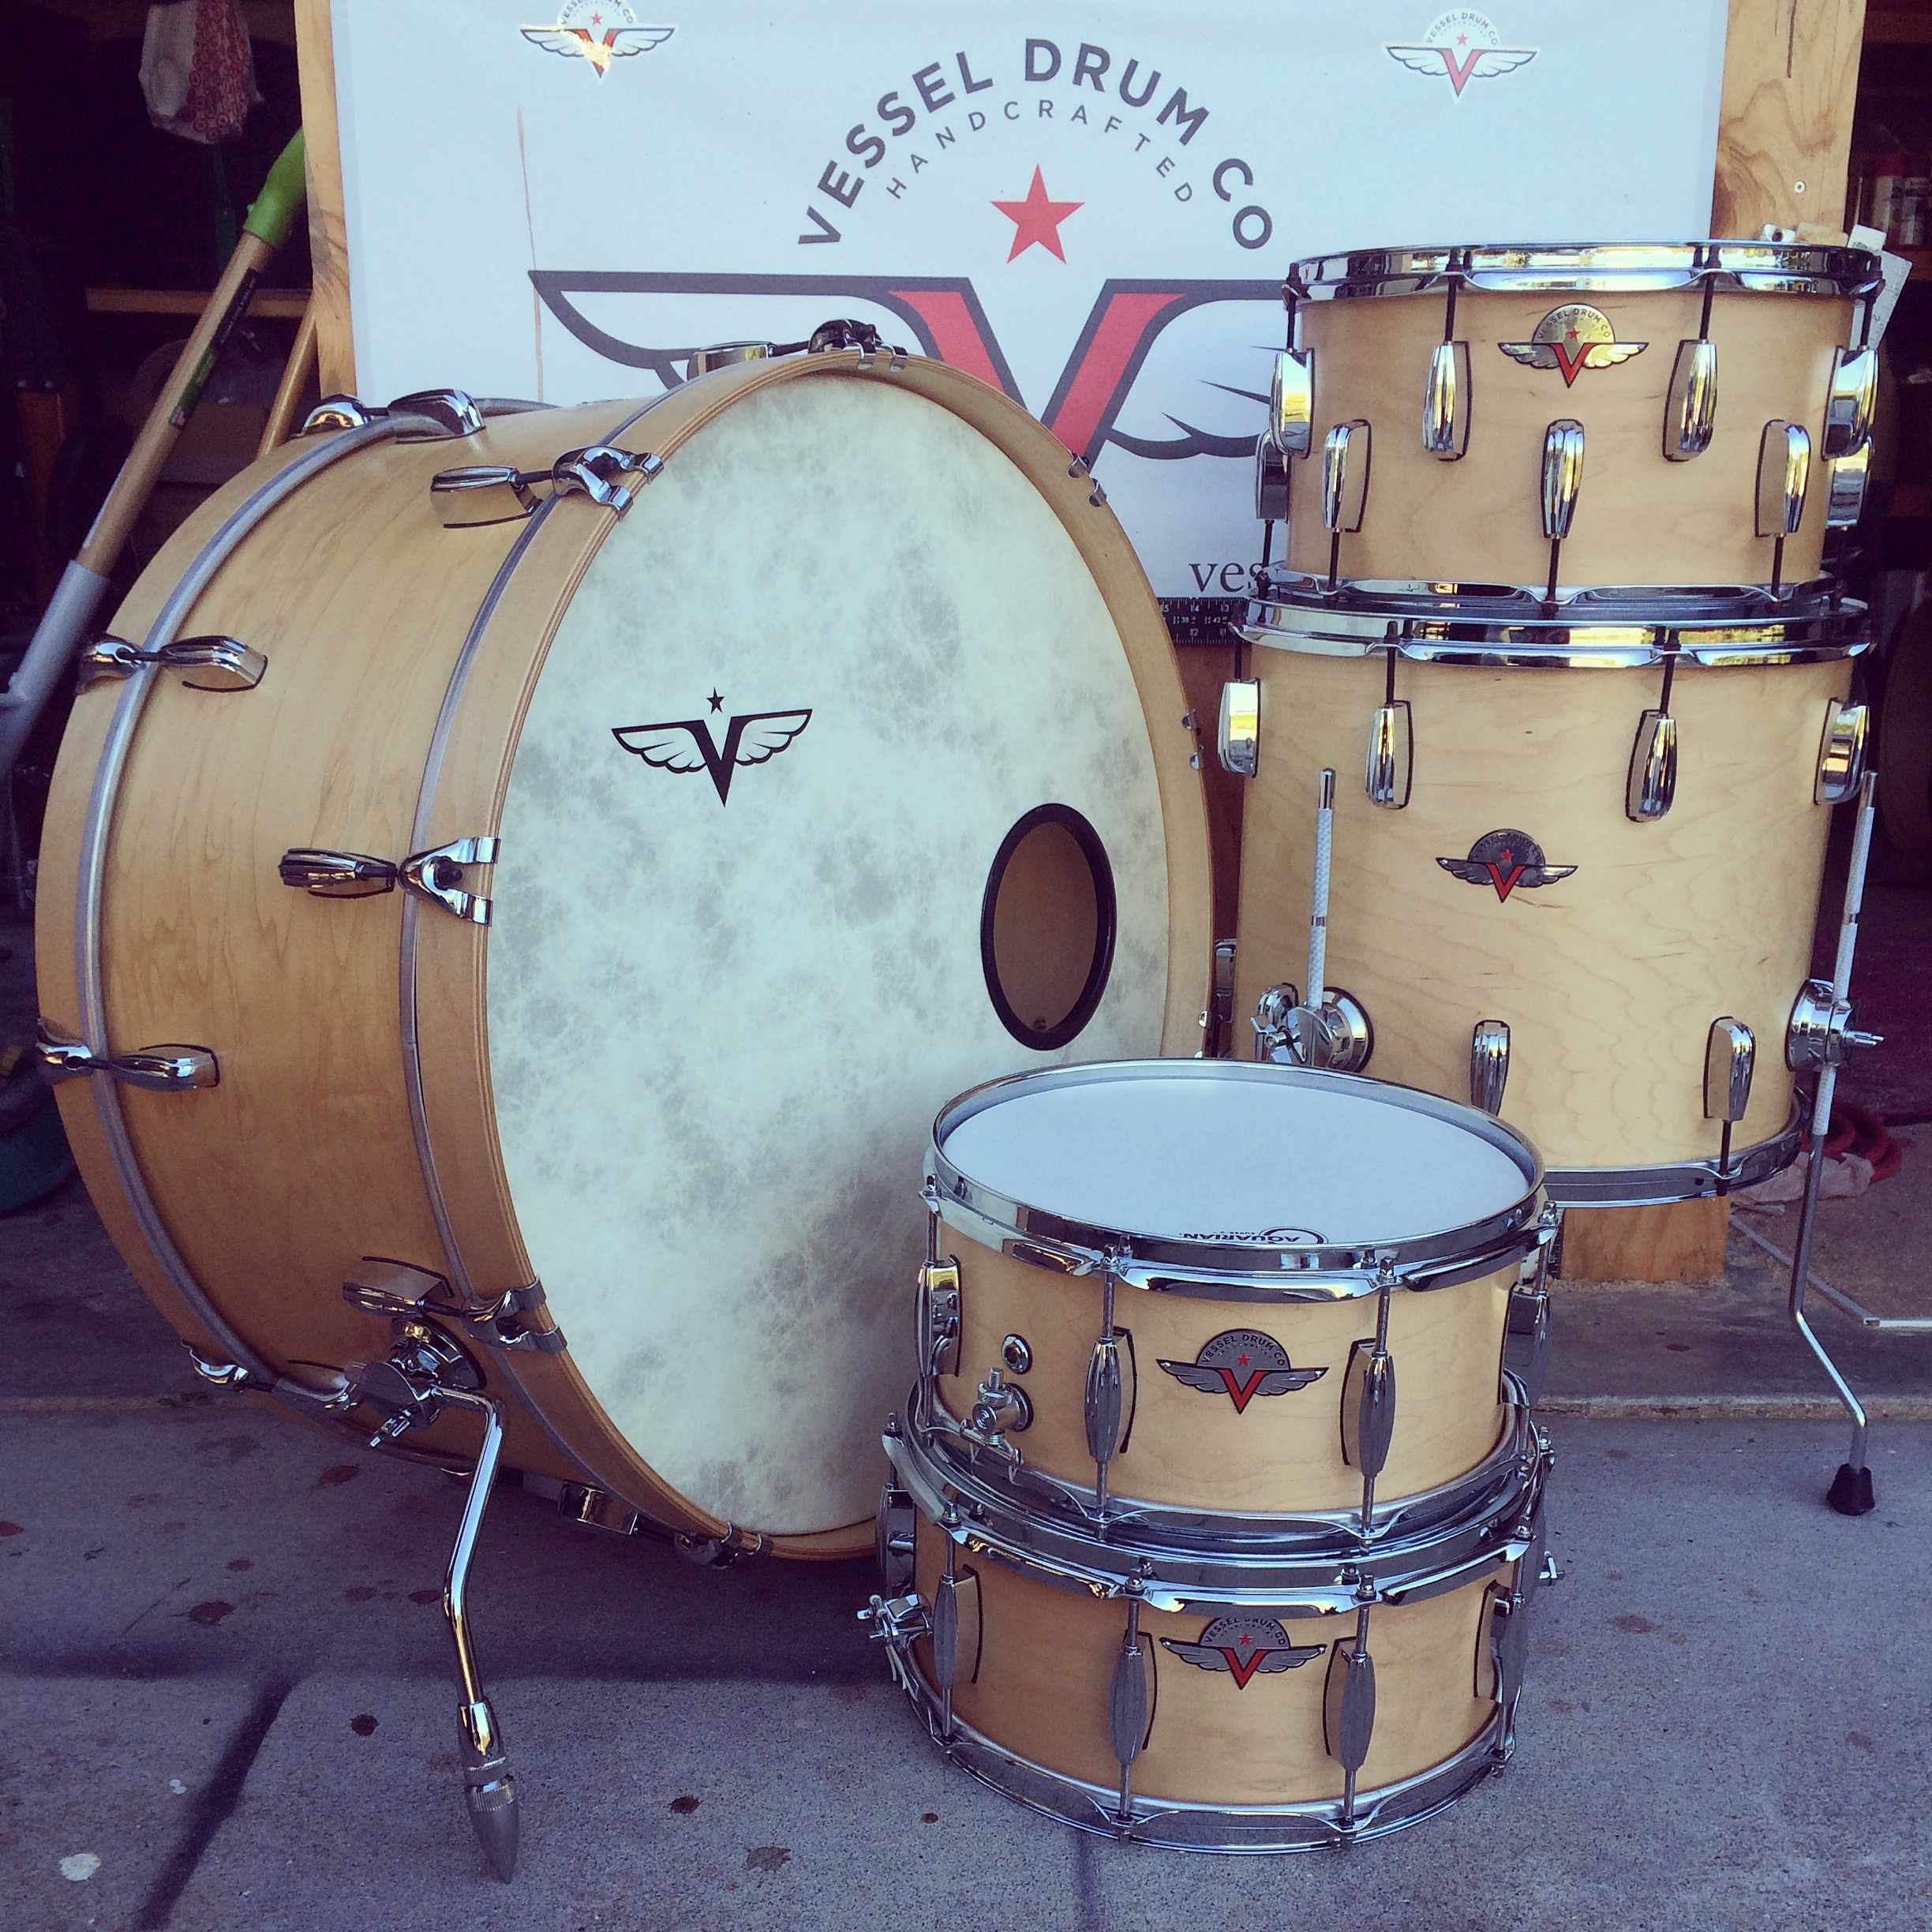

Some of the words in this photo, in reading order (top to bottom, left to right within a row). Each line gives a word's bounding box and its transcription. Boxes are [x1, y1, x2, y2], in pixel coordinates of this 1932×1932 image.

[560, 0, 582, 24] VESS
[623, 9, 634, 24] CO
[1426, 14, 1457, 43] VESSEL
[1462, 12, 1489, 28] DRUM
[1488, 30, 1498, 45] CO
[797, 51, 994, 245] VESSEL
[1024, 38, 1211, 146] DRUM
[1212, 158, 1273, 249] CO
[886, 99, 1193, 203] HANDCRAFTED
[1537, 310, 1569, 339] VESSEL
[1574, 308, 1601, 323] DRUM
[1601, 324, 1611, 338] CO
[1183, 1233, 1301, 1244] AQUARIAN
[1201, 1335, 1238, 1364] VESSEL
[1241, 1334, 1275, 1350] DRUM
[1274, 1352, 1286, 1366] CO
[1204, 1618, 1241, 1642] VESSEL
